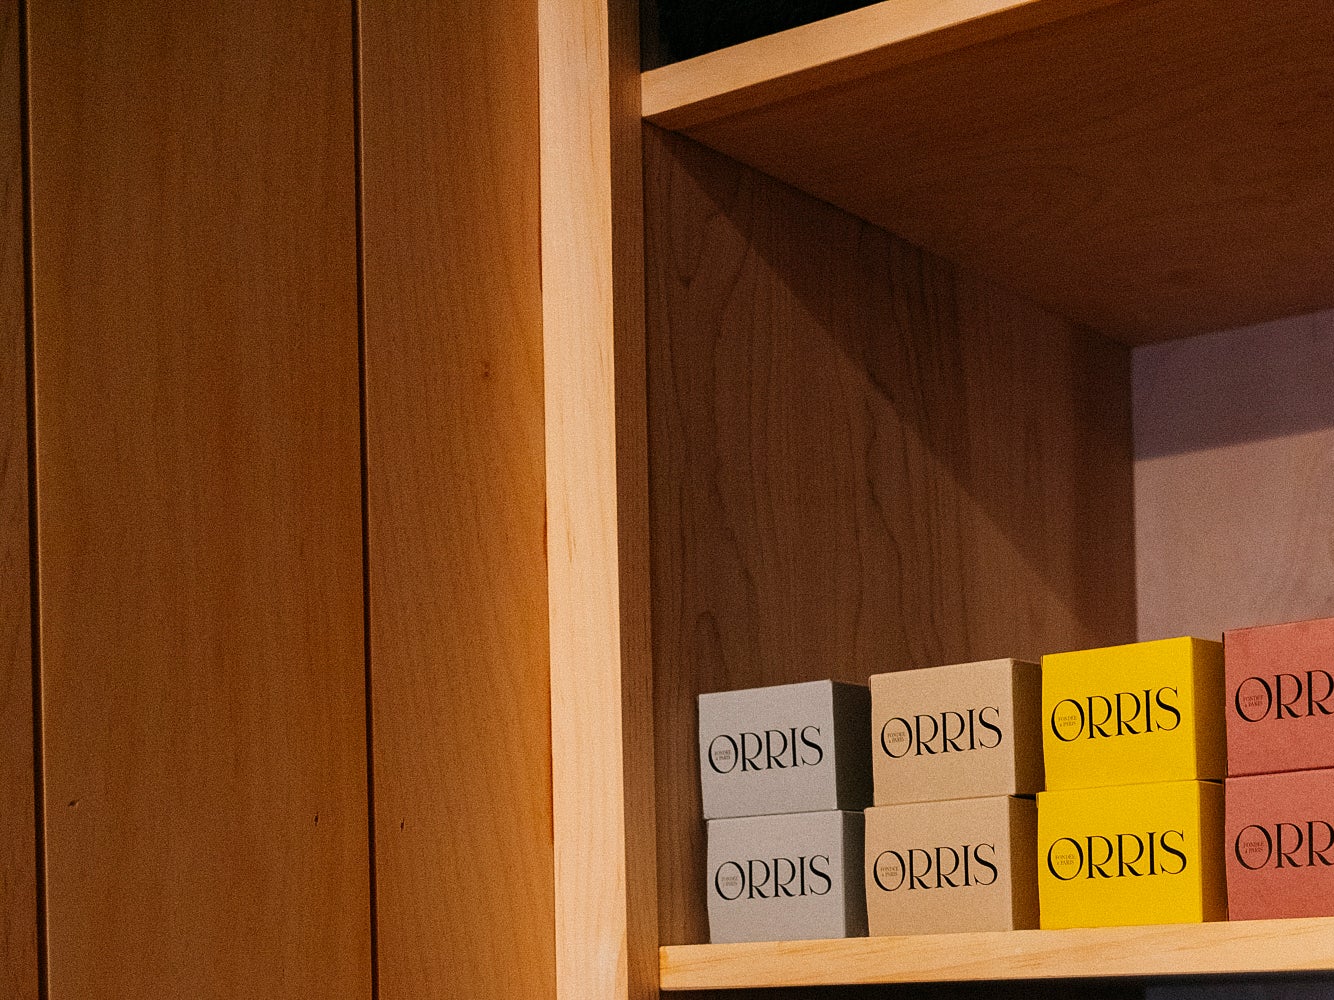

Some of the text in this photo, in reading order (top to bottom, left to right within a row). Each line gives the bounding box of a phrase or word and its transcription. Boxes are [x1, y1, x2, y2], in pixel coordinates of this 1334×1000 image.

[881, 706, 1002, 758] ORRIS
[1051, 686, 1181, 742] ORRIS
[708, 725, 823, 774] ORRIS
[715, 854, 832, 900] ORRIS
[873, 843, 998, 892] ORRIS
[1047, 830, 1187, 881] ORRIS
